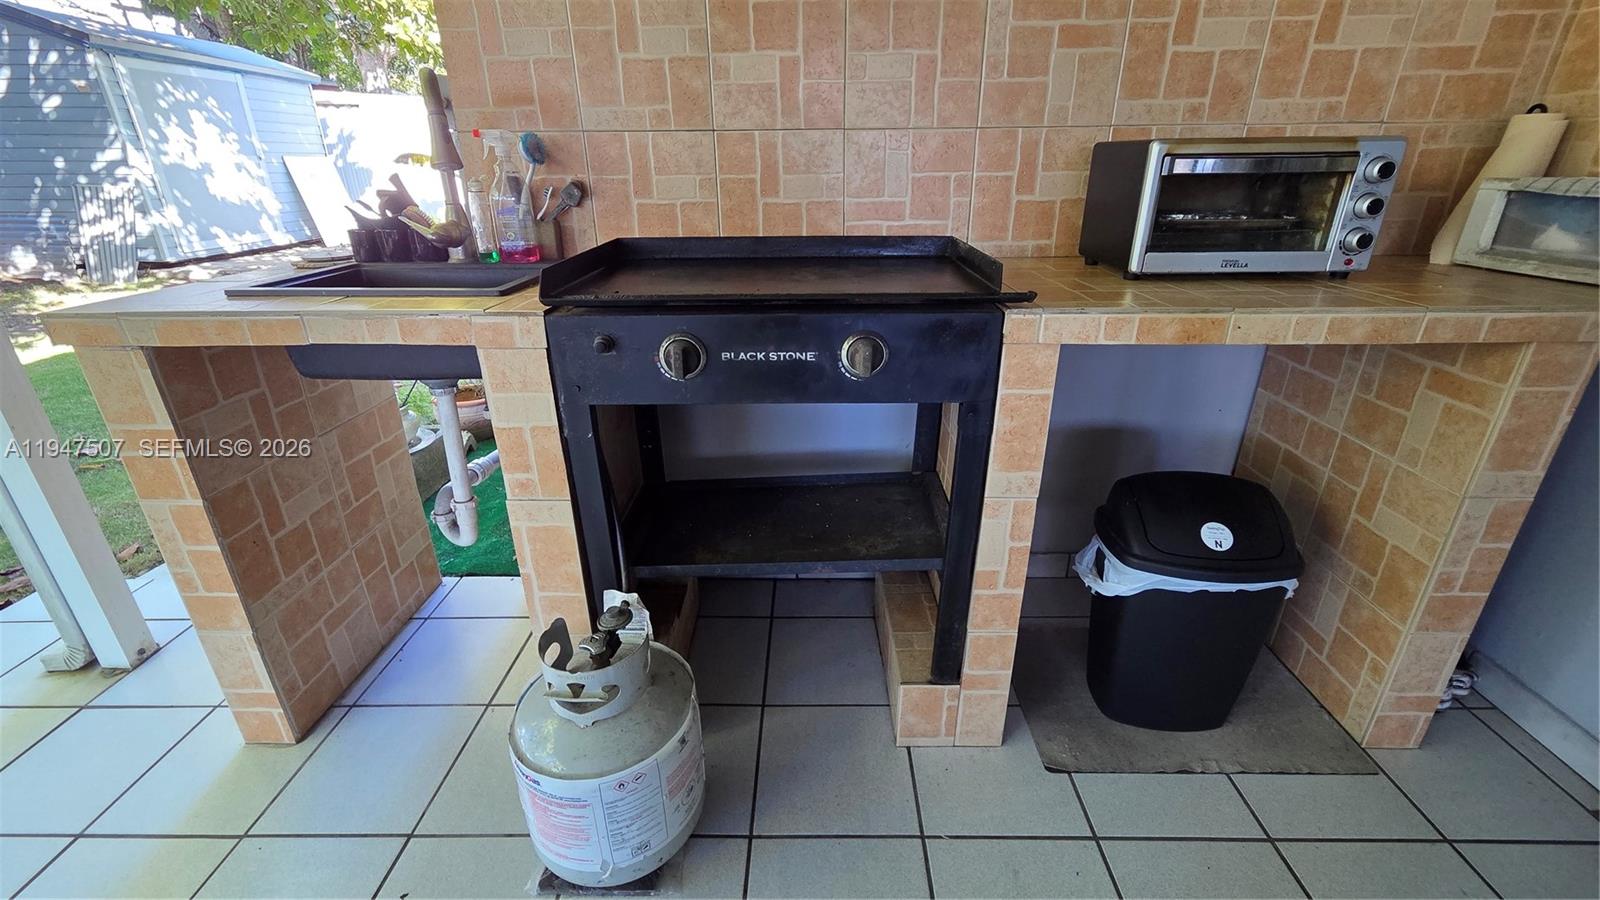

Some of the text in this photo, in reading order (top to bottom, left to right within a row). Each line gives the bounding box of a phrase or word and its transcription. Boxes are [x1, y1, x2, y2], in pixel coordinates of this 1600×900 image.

[721, 351, 816, 361] BLACK STONE
[1214, 540, 1223, 549] N
